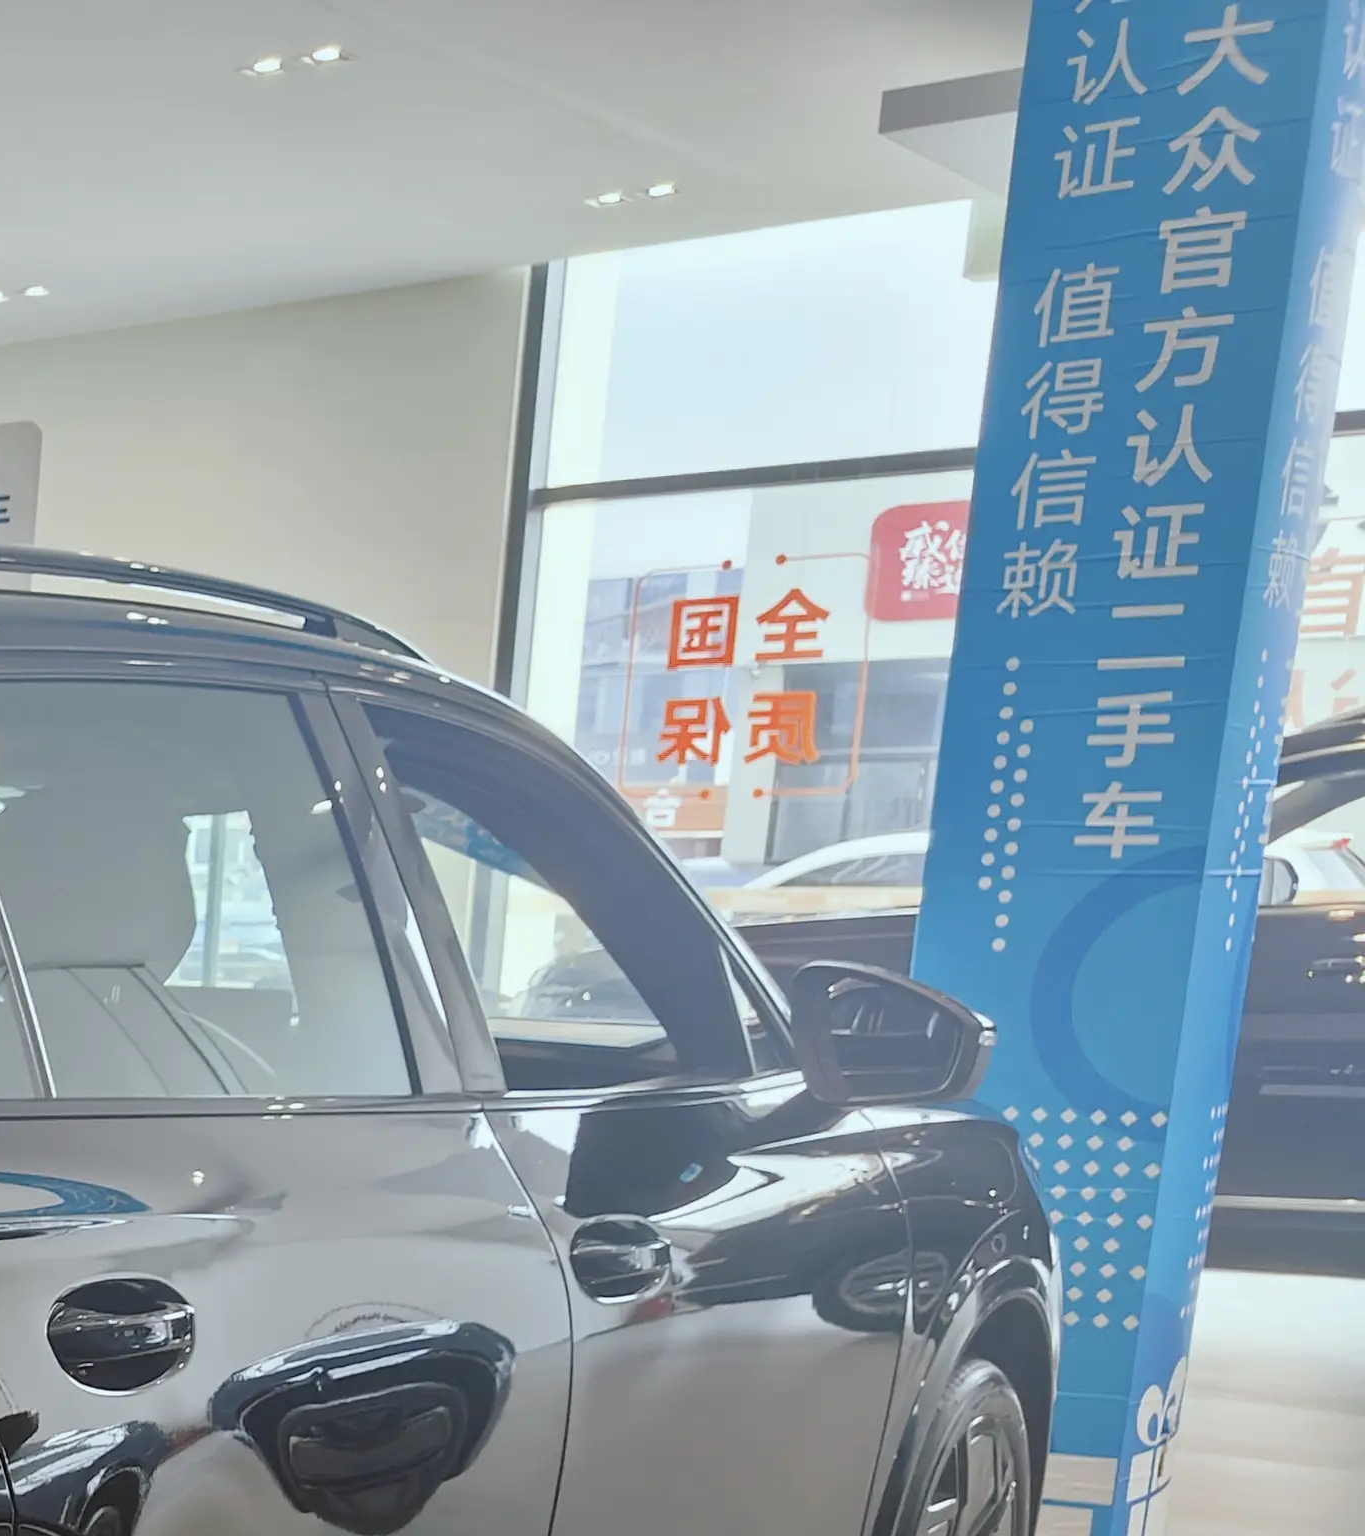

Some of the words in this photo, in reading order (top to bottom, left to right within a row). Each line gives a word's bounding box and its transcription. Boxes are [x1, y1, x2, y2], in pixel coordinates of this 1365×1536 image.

[1054, 0, 1148, 200] 认证
[996, 263, 1120, 619] 值得信赖
[1073, 3, 1274, 859] 大众官方认证二手车
